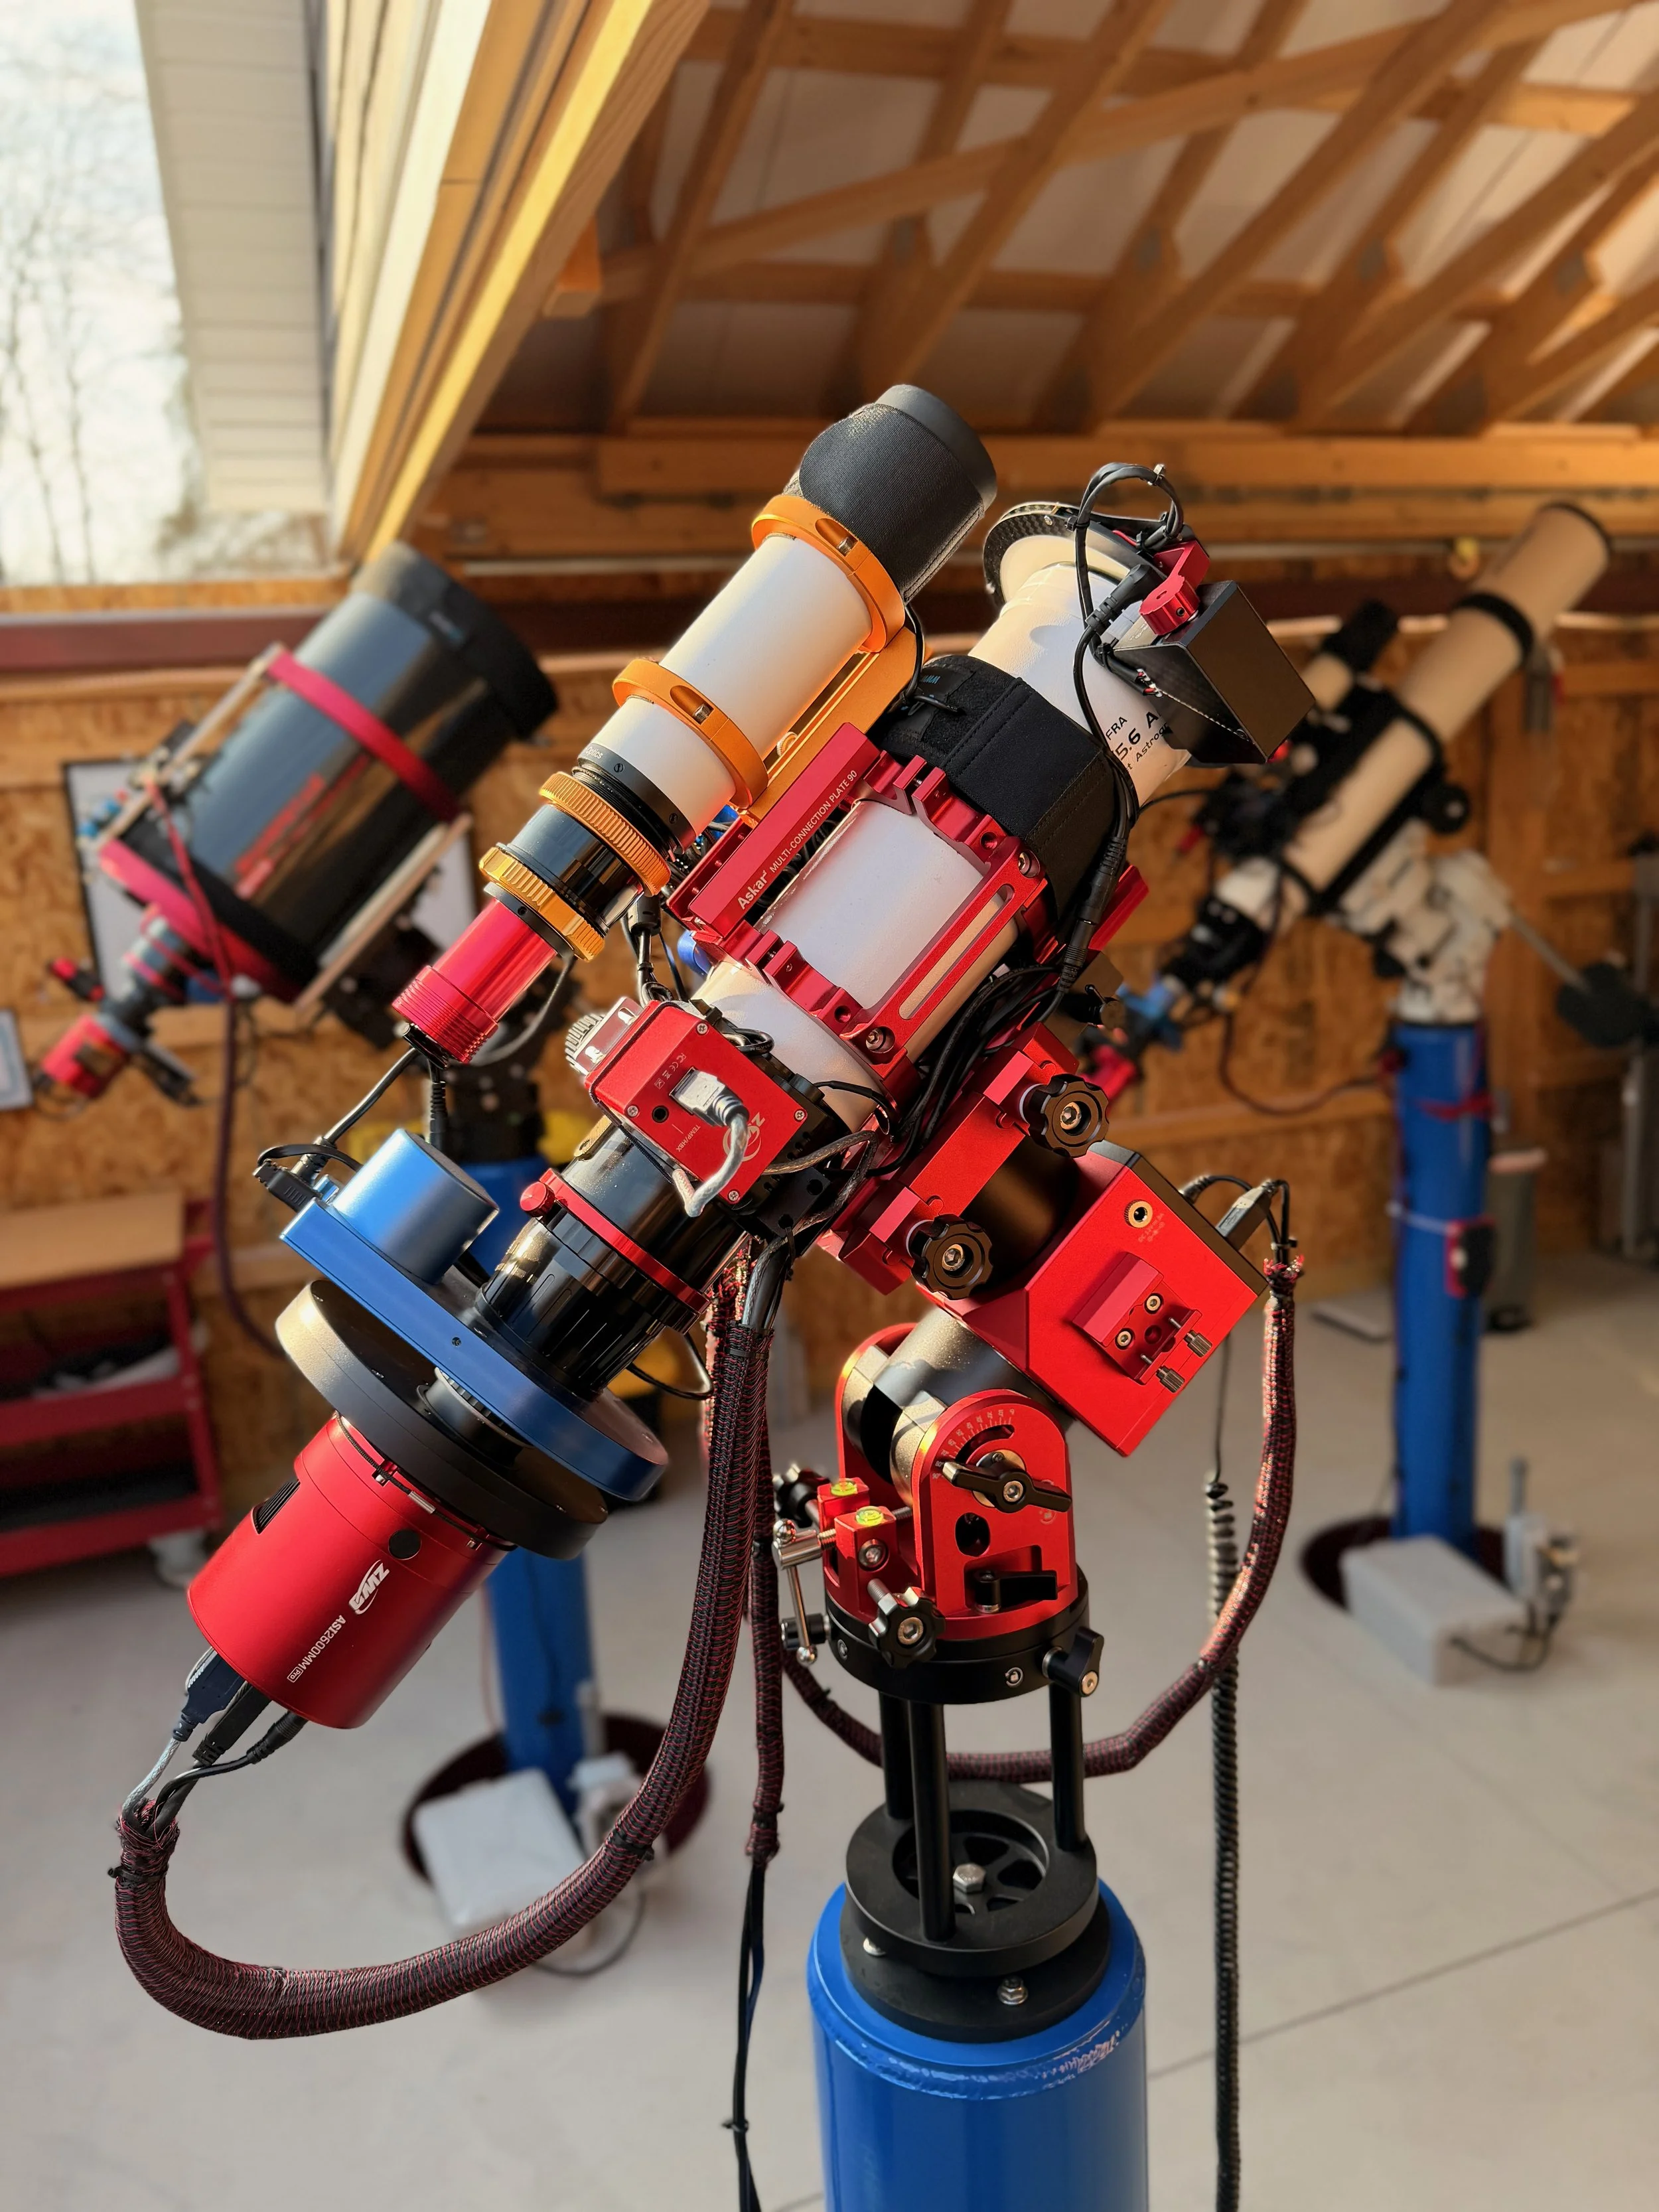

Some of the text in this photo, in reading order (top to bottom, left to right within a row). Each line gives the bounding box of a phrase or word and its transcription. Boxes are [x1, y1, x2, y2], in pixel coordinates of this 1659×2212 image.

[1106, 717, 1127, 741] FRA
[1114, 727, 1141, 761] 5.6
[737, 770, 857, 910] Askar MULTI-CONNECTION PLATE 90
[676, 1124, 701, 1152] TEMP/HBX
[348, 1560, 390, 1615] ZWO
[289, 1615, 346, 1680] ASI2600MM Pro
